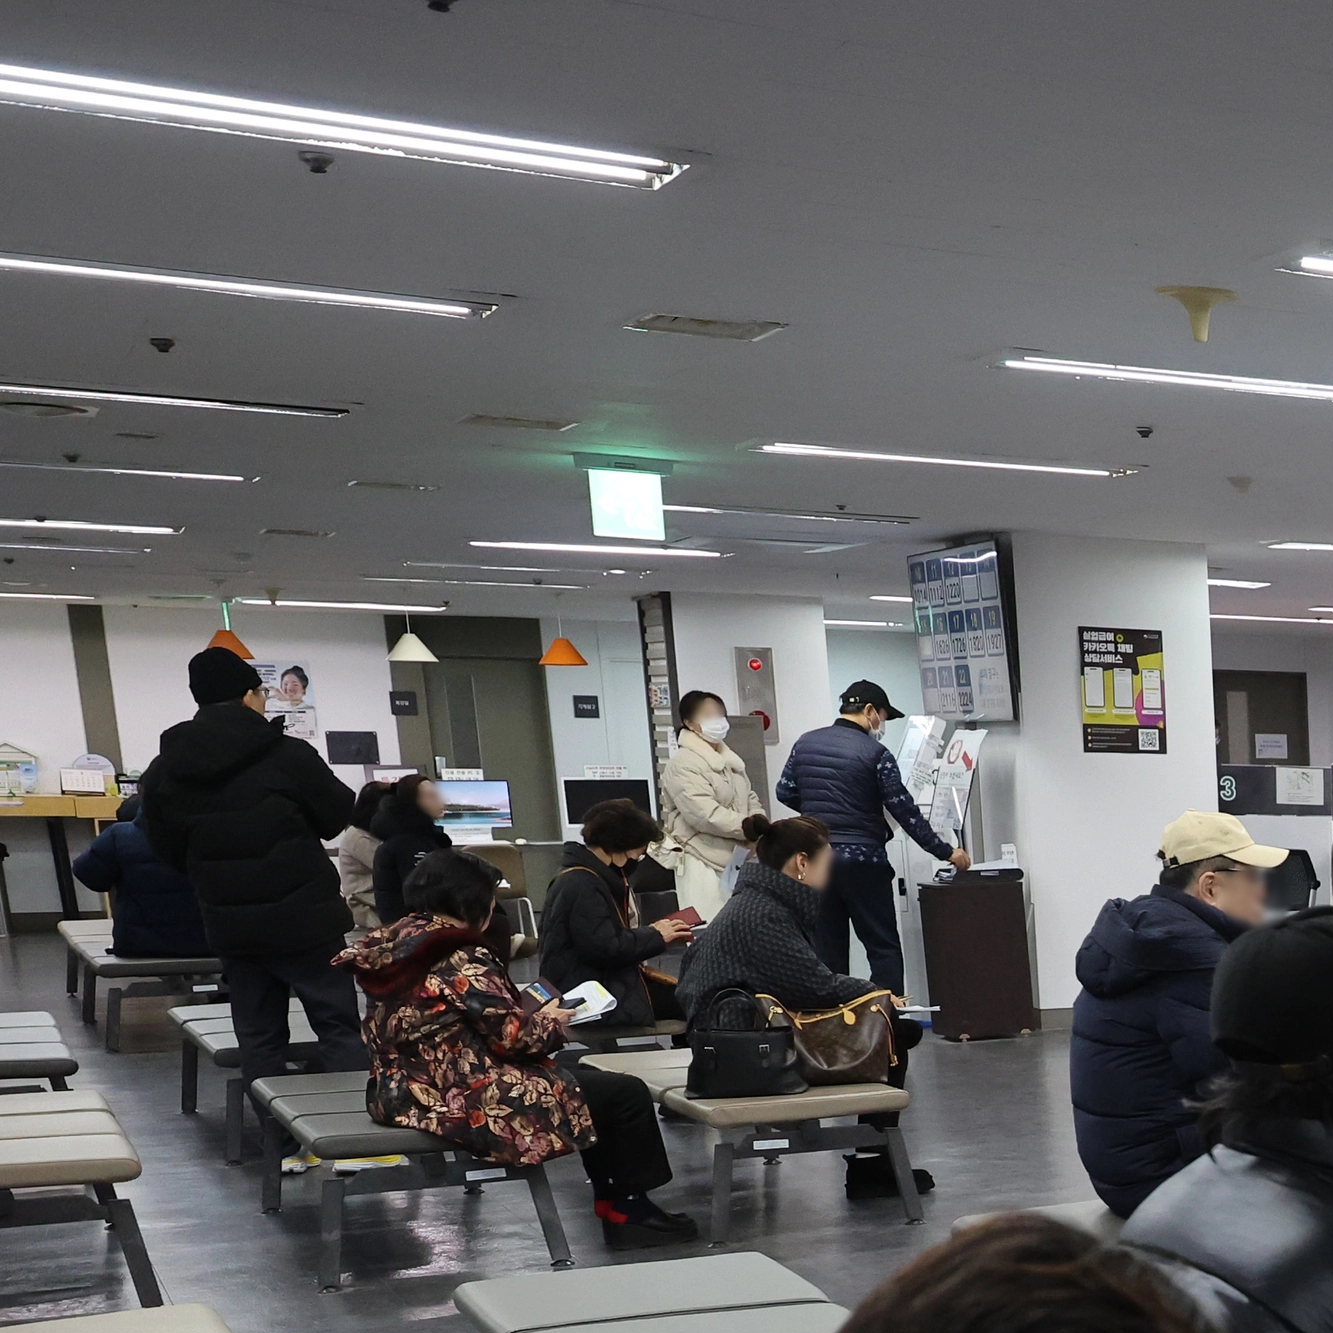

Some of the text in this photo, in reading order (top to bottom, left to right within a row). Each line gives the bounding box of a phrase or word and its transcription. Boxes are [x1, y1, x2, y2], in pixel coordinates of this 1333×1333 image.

[1082, 631, 1115, 642] 실업급여
[952, 636, 966, 653] 1726
[987, 633, 1002, 650] 1927
[1083, 642, 1115, 653] 카카오톡
[1084, 653, 1124, 664] 상담서비스
[959, 669, 967, 684] 22
